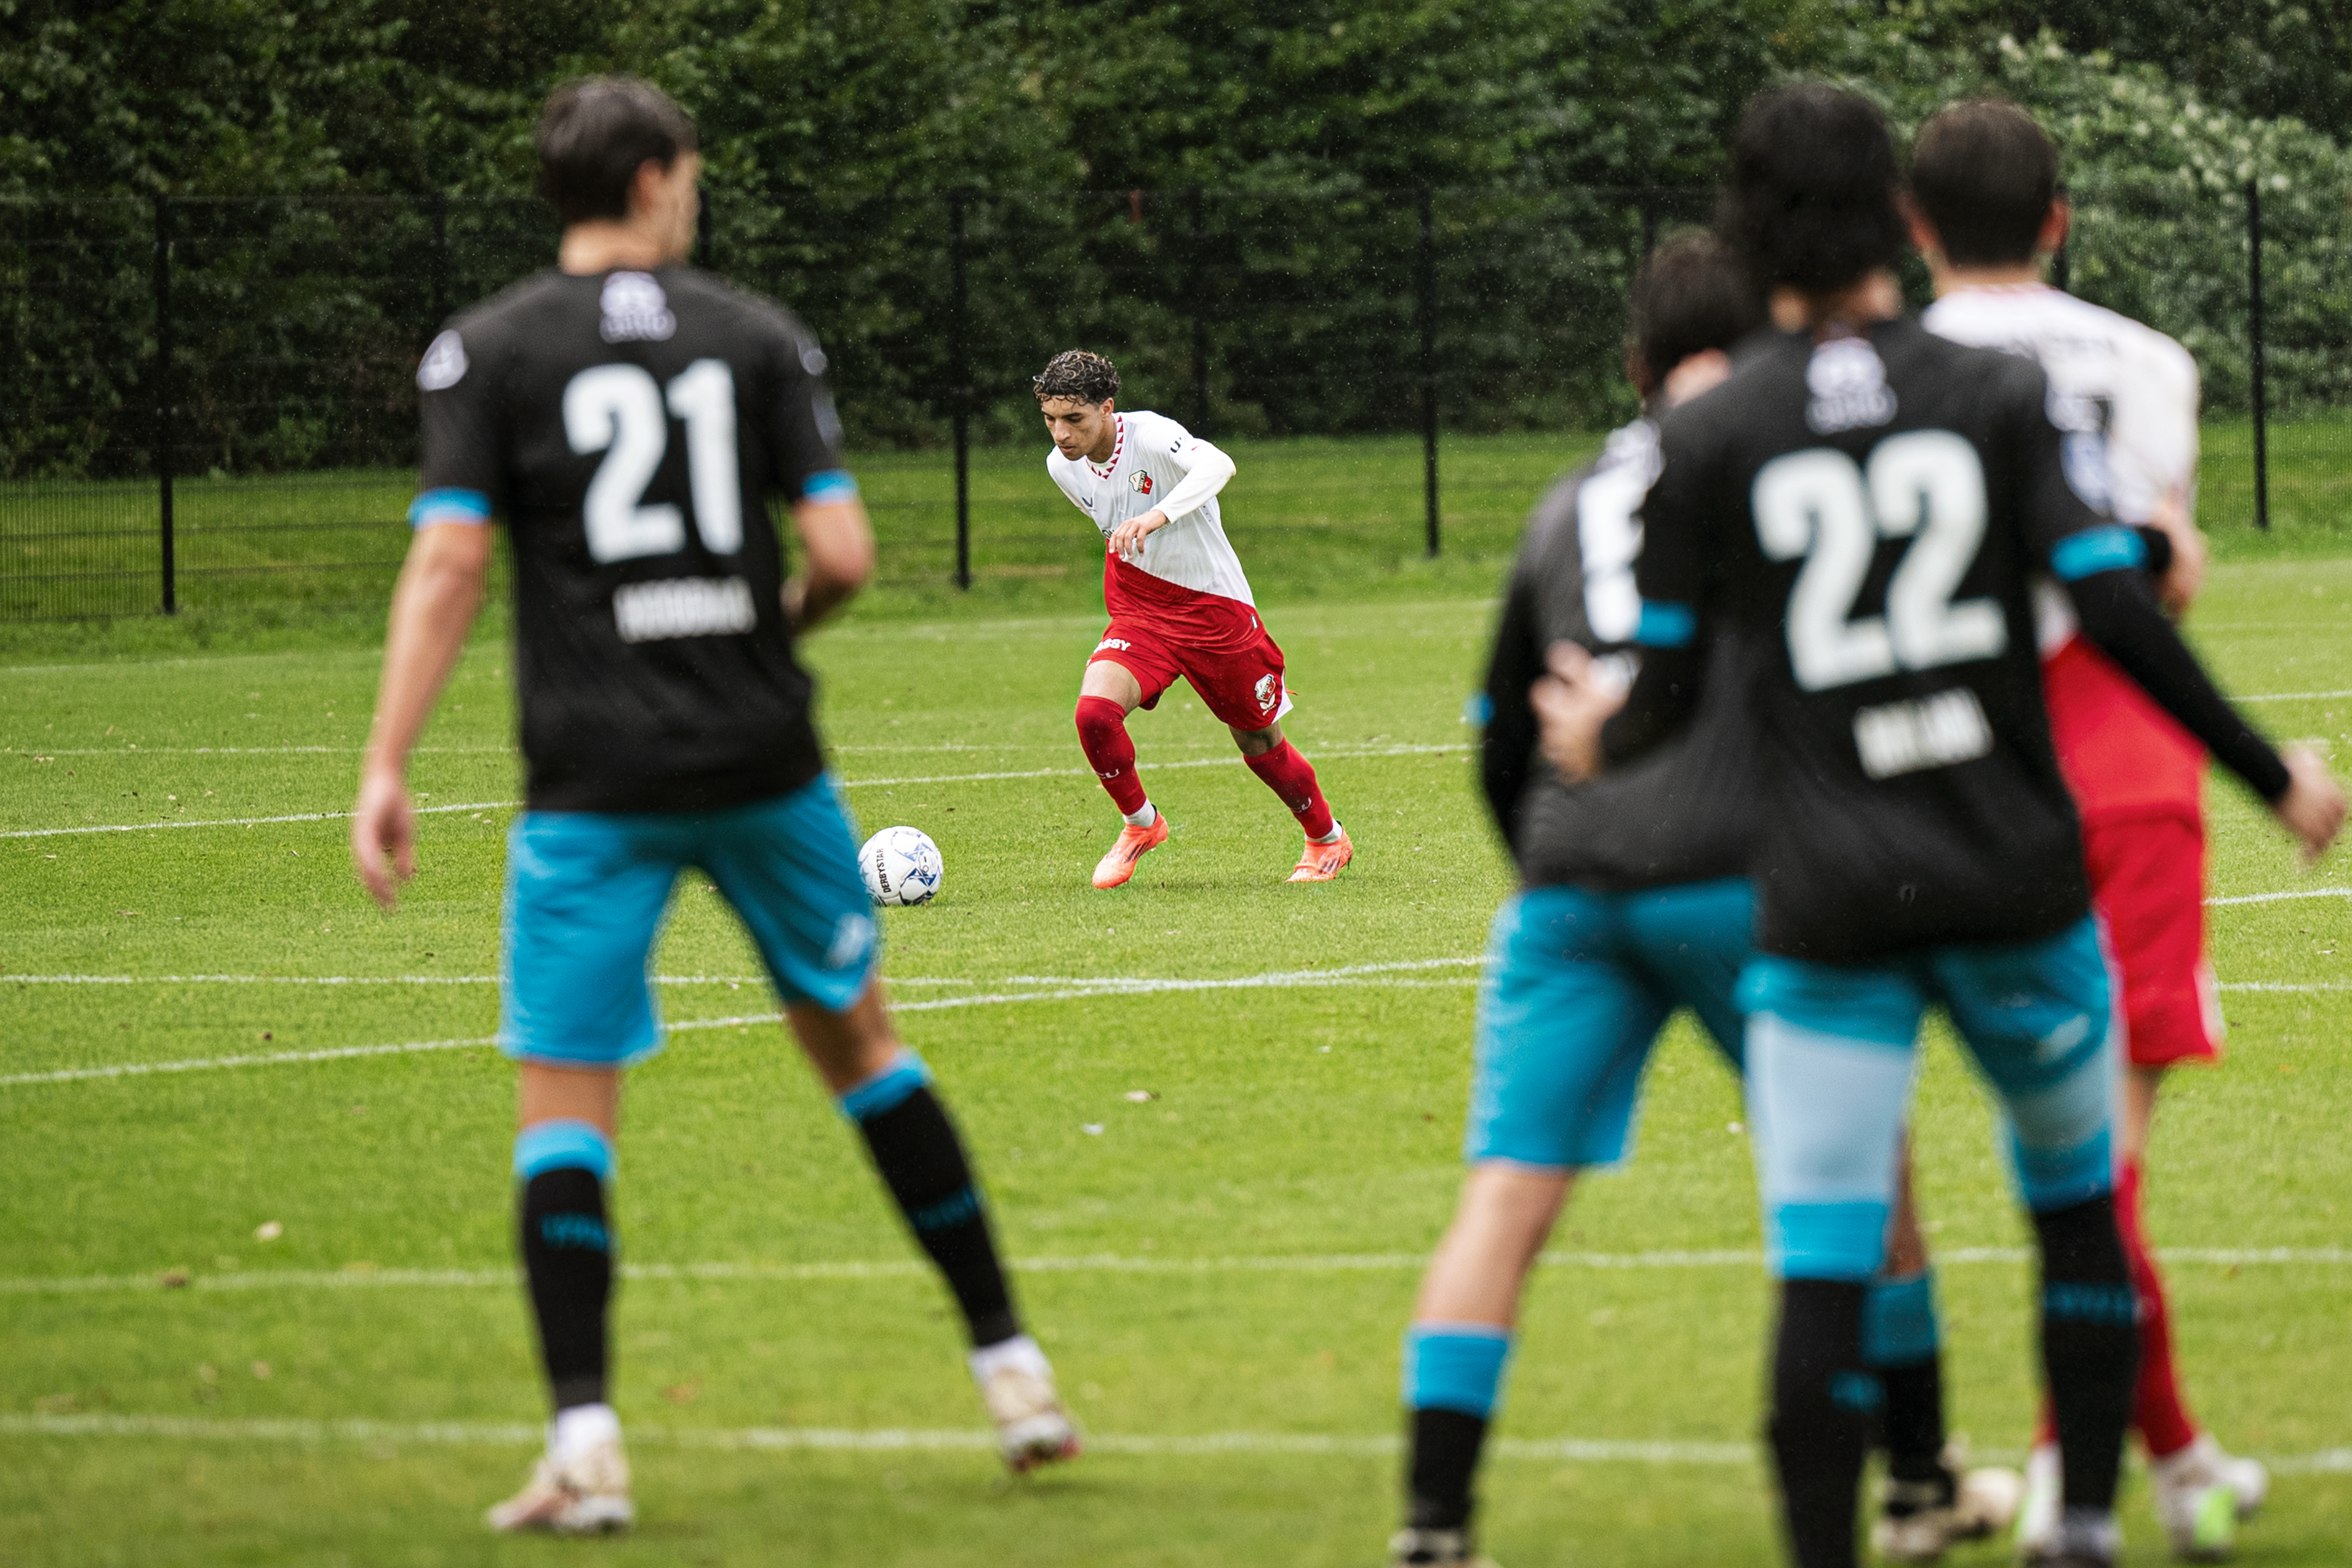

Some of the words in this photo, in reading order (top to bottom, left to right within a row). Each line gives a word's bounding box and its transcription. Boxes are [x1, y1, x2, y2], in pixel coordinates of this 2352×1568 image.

[561, 358, 743, 563] 21
[1751, 429, 2006, 690] 22
[876, 848, 891, 893] DERBYSTAR
